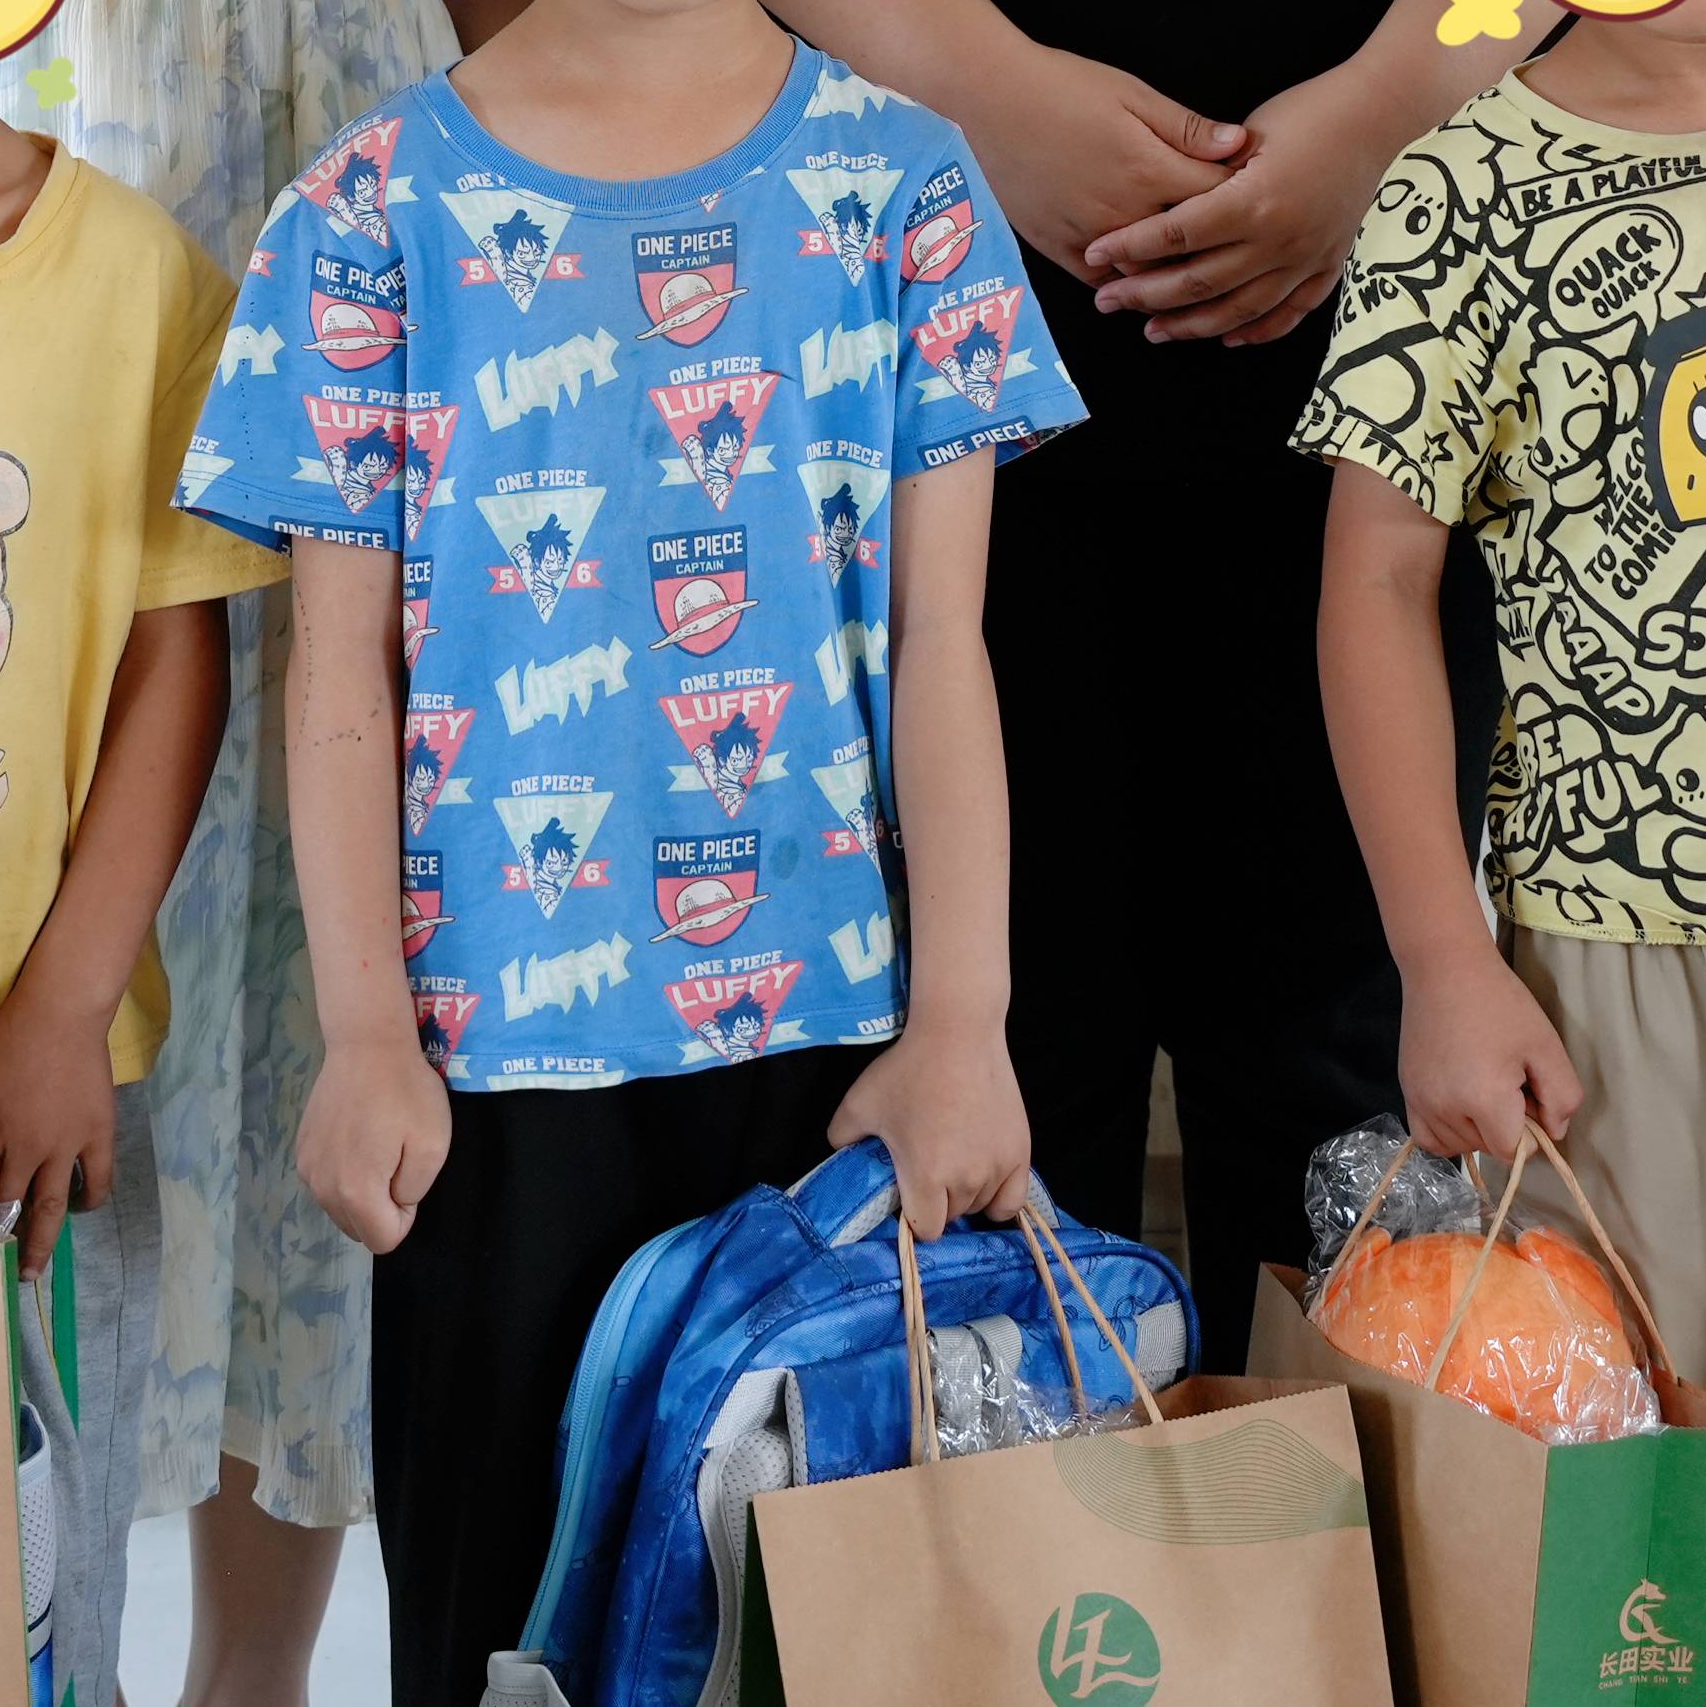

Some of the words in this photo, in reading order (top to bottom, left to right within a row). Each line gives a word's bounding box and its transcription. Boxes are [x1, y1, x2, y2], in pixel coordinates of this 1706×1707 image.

[294, 117, 397, 195] LUFFY
[805, 151, 839, 171] ONE
[841, 153, 889, 171] PIECE
[456, 172, 492, 192] ONE
[918, 167, 965, 206] PIECE
[1522, 184, 1554, 217] BE
[1565, 178, 1584, 205] A
[1593, 154, 1706, 197] PLAYFUL
[906, 196, 954, 228] CAPTAIN
[637, 236, 674, 257] ONE
[680, 228, 733, 254] PIECE
[808, 232, 822, 252] 5
[315, 257, 341, 283] ONE
[469, 261, 484, 281] 5
[556, 256, 574, 275] 6
[661, 254, 710, 270] CAPTAIN
[1555, 224, 1661, 307] QUACK
[327, 285, 376, 305] CAPTAIN
[962, 277, 1005, 301] PIECE
[1592, 260, 1660, 318] QUACK
[917, 289, 1019, 347] LUFFY
[474, 326, 620, 433] LUFFY
[669, 362, 708, 385] ONE
[711, 356, 762, 376] PIECE
[322, 385, 361, 401] ONE
[656, 374, 775, 420] LUFFY
[806, 440, 832, 461] ONE
[836, 440, 884, 468] PIECE
[924, 441, 969, 467] ONE
[973, 421, 1029, 450] PIECE
[495, 471, 534, 495] ONE
[538, 468, 587, 488] PIECE
[652, 540, 688, 563] ONE
[694, 531, 743, 558] PIECE
[1583, 544, 1617, 584] TO
[1612, 486, 1657, 545] THE
[860, 543, 870, 560] 6
[499, 568, 514, 589] 5
[576, 563, 592, 584] 6
[676, 559, 724, 575] CAPTAIN
[495, 635, 632, 736] LUFFY
[680, 673, 719, 694] ONE
[723, 668, 775, 687] PIECE
[413, 694, 454, 710] PIECE
[666, 684, 789, 728] LUFFY
[512, 776, 539, 796] ONE
[542, 775, 594, 793] PIECE
[657, 841, 696, 862] ONE
[702, 835, 756, 860] PIECE
[834, 833, 851, 851] 5
[509, 867, 521, 887] 5
[583, 863, 600, 882] 6
[681, 862, 733, 875] CAPTAIN
[498, 930, 634, 1023] LUFFY
[684, 959, 725, 980] ONE
[730, 949, 783, 973] PIECE
[421, 977, 466, 993] PIECE
[672, 963, 799, 1010] LUFFY
[502, 1056, 537, 1075] ONE
[543, 1056, 605, 1073] PIECE
[1599, 1645, 1695, 1679] 长田实业
